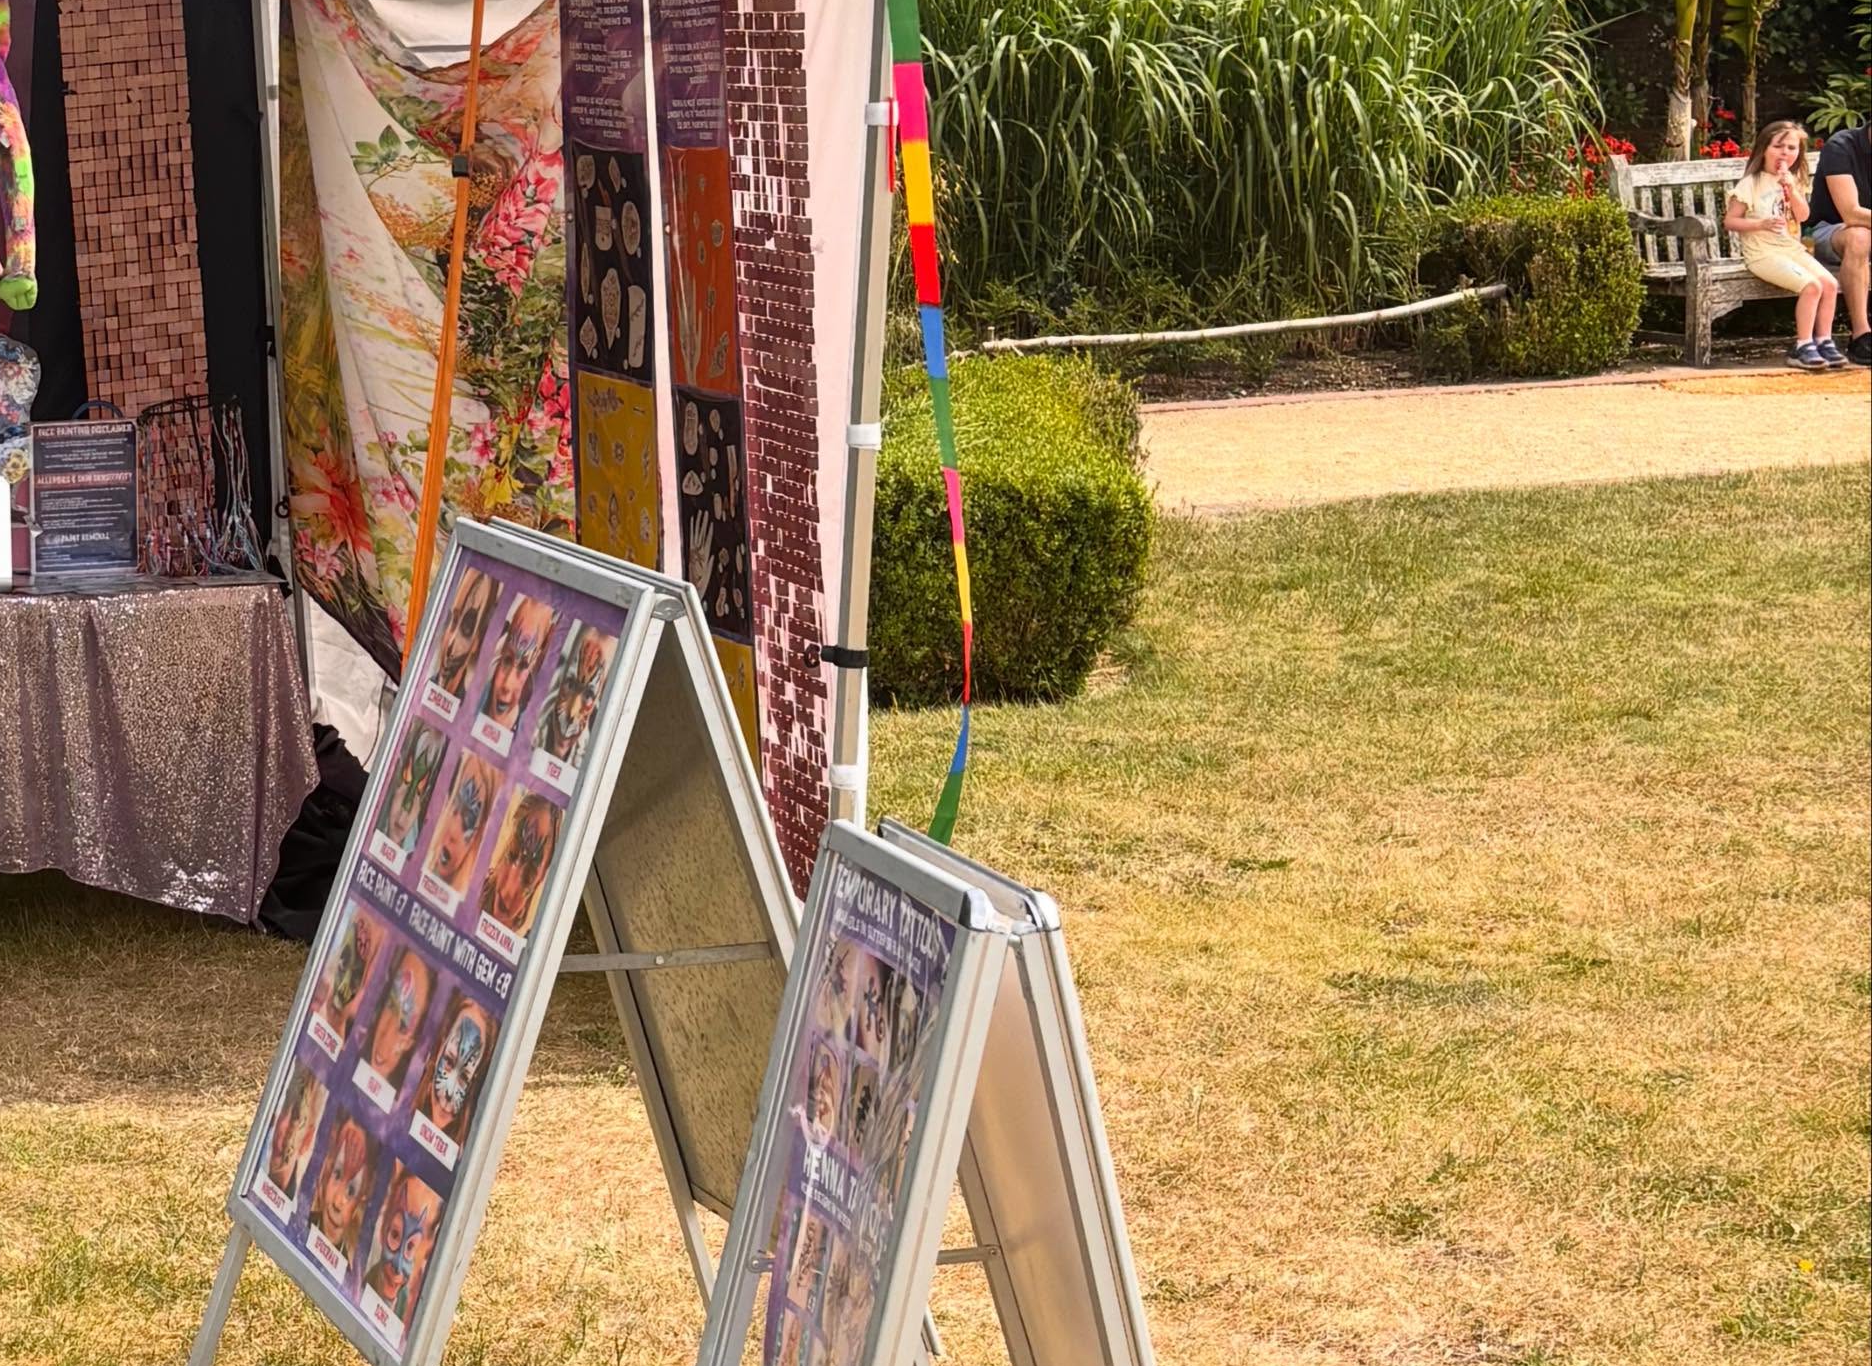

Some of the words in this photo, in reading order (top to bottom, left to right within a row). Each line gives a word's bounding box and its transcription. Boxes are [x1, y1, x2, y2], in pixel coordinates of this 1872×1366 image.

[356, 859, 377, 893] FACE
[408, 902, 431, 937] FACE
[475, 953, 499, 989] GEM
[495, 973, 513, 1001] £8
[835, 863, 899, 930] TEMPORARY
